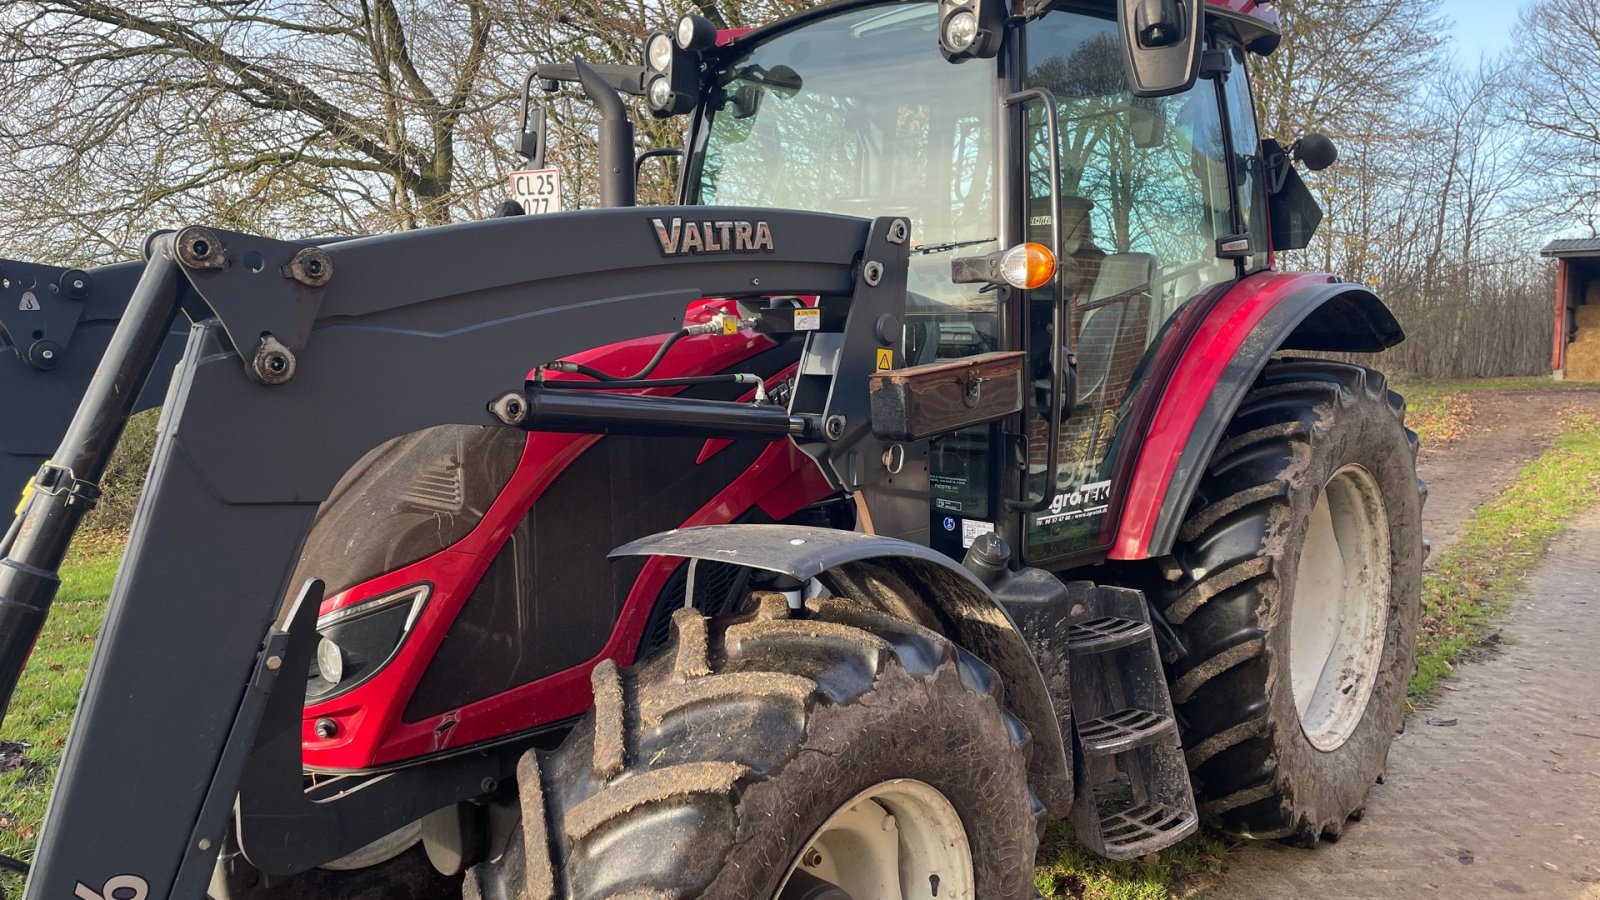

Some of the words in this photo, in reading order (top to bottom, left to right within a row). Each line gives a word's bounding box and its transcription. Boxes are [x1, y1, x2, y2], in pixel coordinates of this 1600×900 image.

[523, 198, 549, 215] 077
[650, 216, 774, 255] VALTRA
[1048, 480, 1112, 514] groTEK
